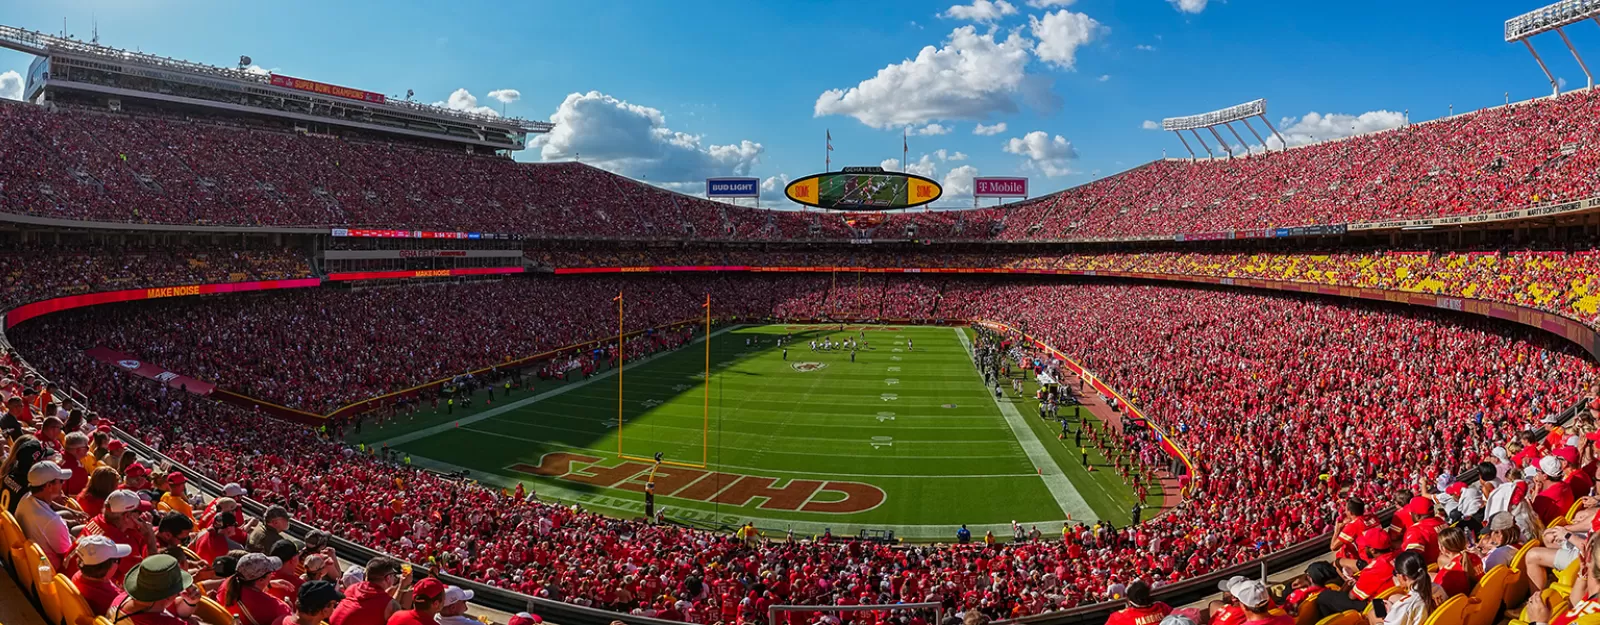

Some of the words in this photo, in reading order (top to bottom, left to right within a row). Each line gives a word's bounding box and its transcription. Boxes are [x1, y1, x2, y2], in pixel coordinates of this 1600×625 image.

[295, 80, 314, 92] SUPER
[315, 84, 332, 95] BOWL
[332, 86, 364, 100] CHAMPIONS
[794, 185, 810, 198] SOME
[916, 185, 932, 198] SOME
[990, 181, 1023, 193] Mobile
[147, 287, 173, 299] MAKE
[173, 285, 200, 297] NOISE
[503, 451, 887, 515] CHIEFS
